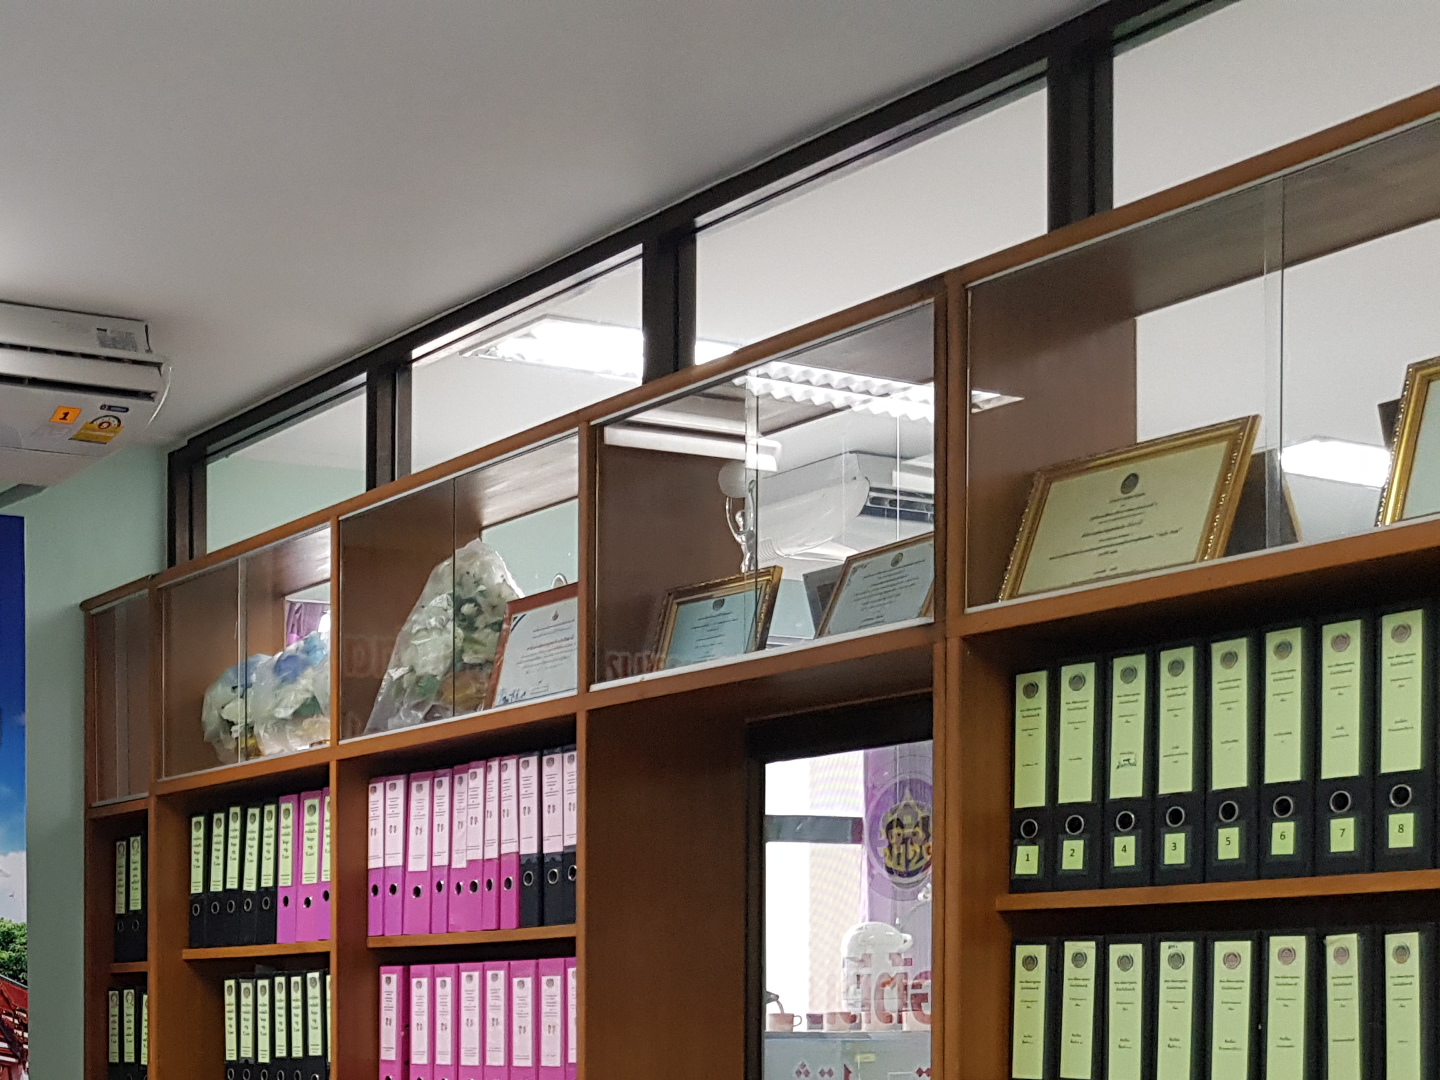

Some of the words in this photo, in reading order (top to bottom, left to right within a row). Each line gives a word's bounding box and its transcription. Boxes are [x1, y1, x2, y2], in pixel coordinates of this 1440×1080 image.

[1338, 827, 1347, 839] 7
[1396, 822, 1405, 835] 8
[1224, 835, 1232, 847] 5
[1278, 830, 1287, 842] 6
[1068, 847, 1076, 858] 2
[1120, 843, 1128, 854] 4
[1170, 841, 1178, 853] 3
[1024, 852, 1031, 863] 1
